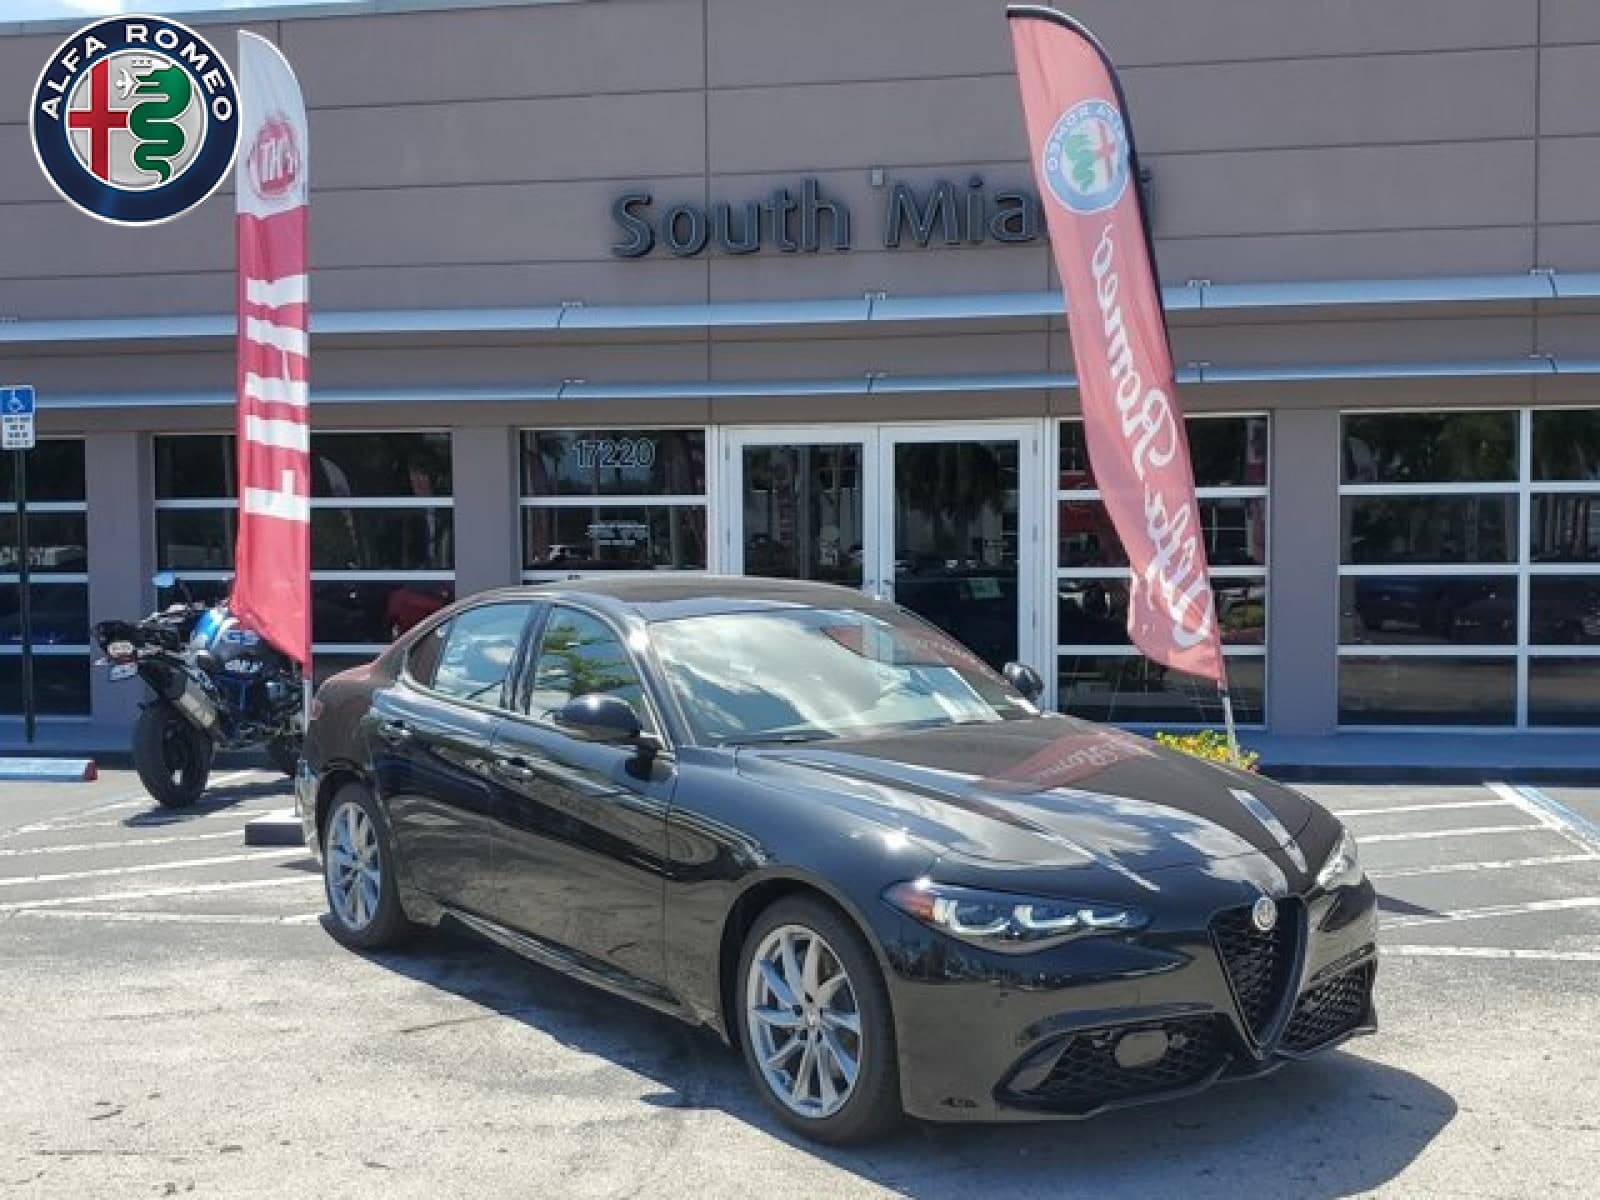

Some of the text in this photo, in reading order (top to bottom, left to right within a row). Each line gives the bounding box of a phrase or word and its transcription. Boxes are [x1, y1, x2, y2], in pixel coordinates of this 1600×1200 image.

[611, 166, 1154, 258] South Miai
[572, 436, 656, 468] 17220
